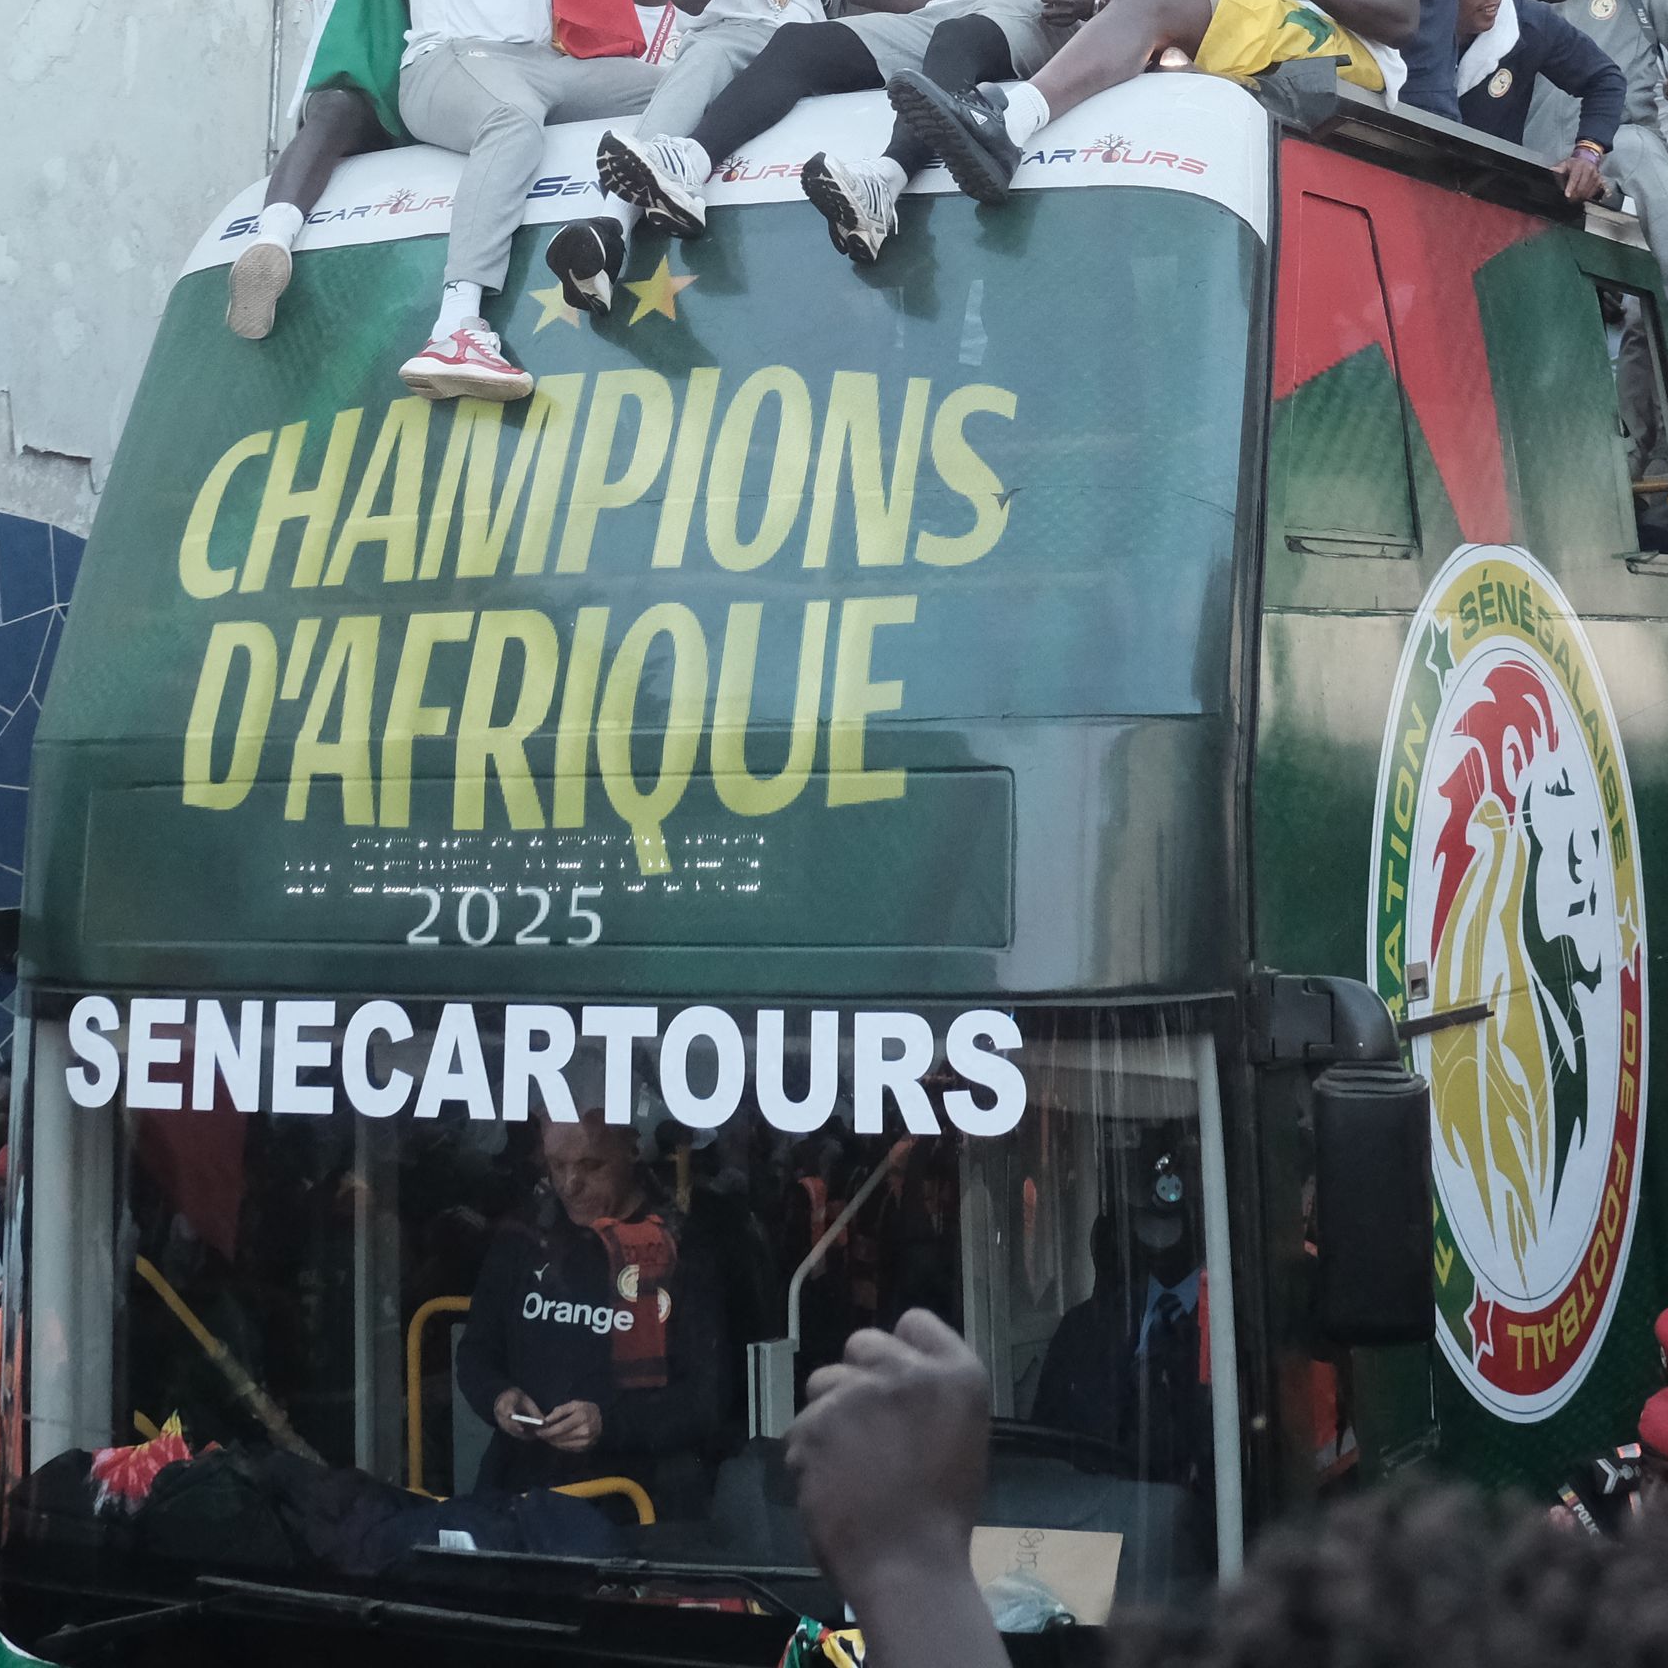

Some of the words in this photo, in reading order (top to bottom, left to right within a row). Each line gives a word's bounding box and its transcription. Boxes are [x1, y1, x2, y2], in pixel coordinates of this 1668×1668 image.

[179, 366, 1017, 599] CHAMPIONS
[183, 596, 919, 875] D'AFRIQUE
[1459, 569, 1627, 870] SÉNÉGALAISE
[406, 886, 604, 947] 2025
[67, 995, 1029, 1137] SENECARTOURS
[1620, 1009, 1637, 1120] DE
[523, 1292, 634, 1334] Orange
[1507, 1140, 1628, 1371] FOOTBALL
